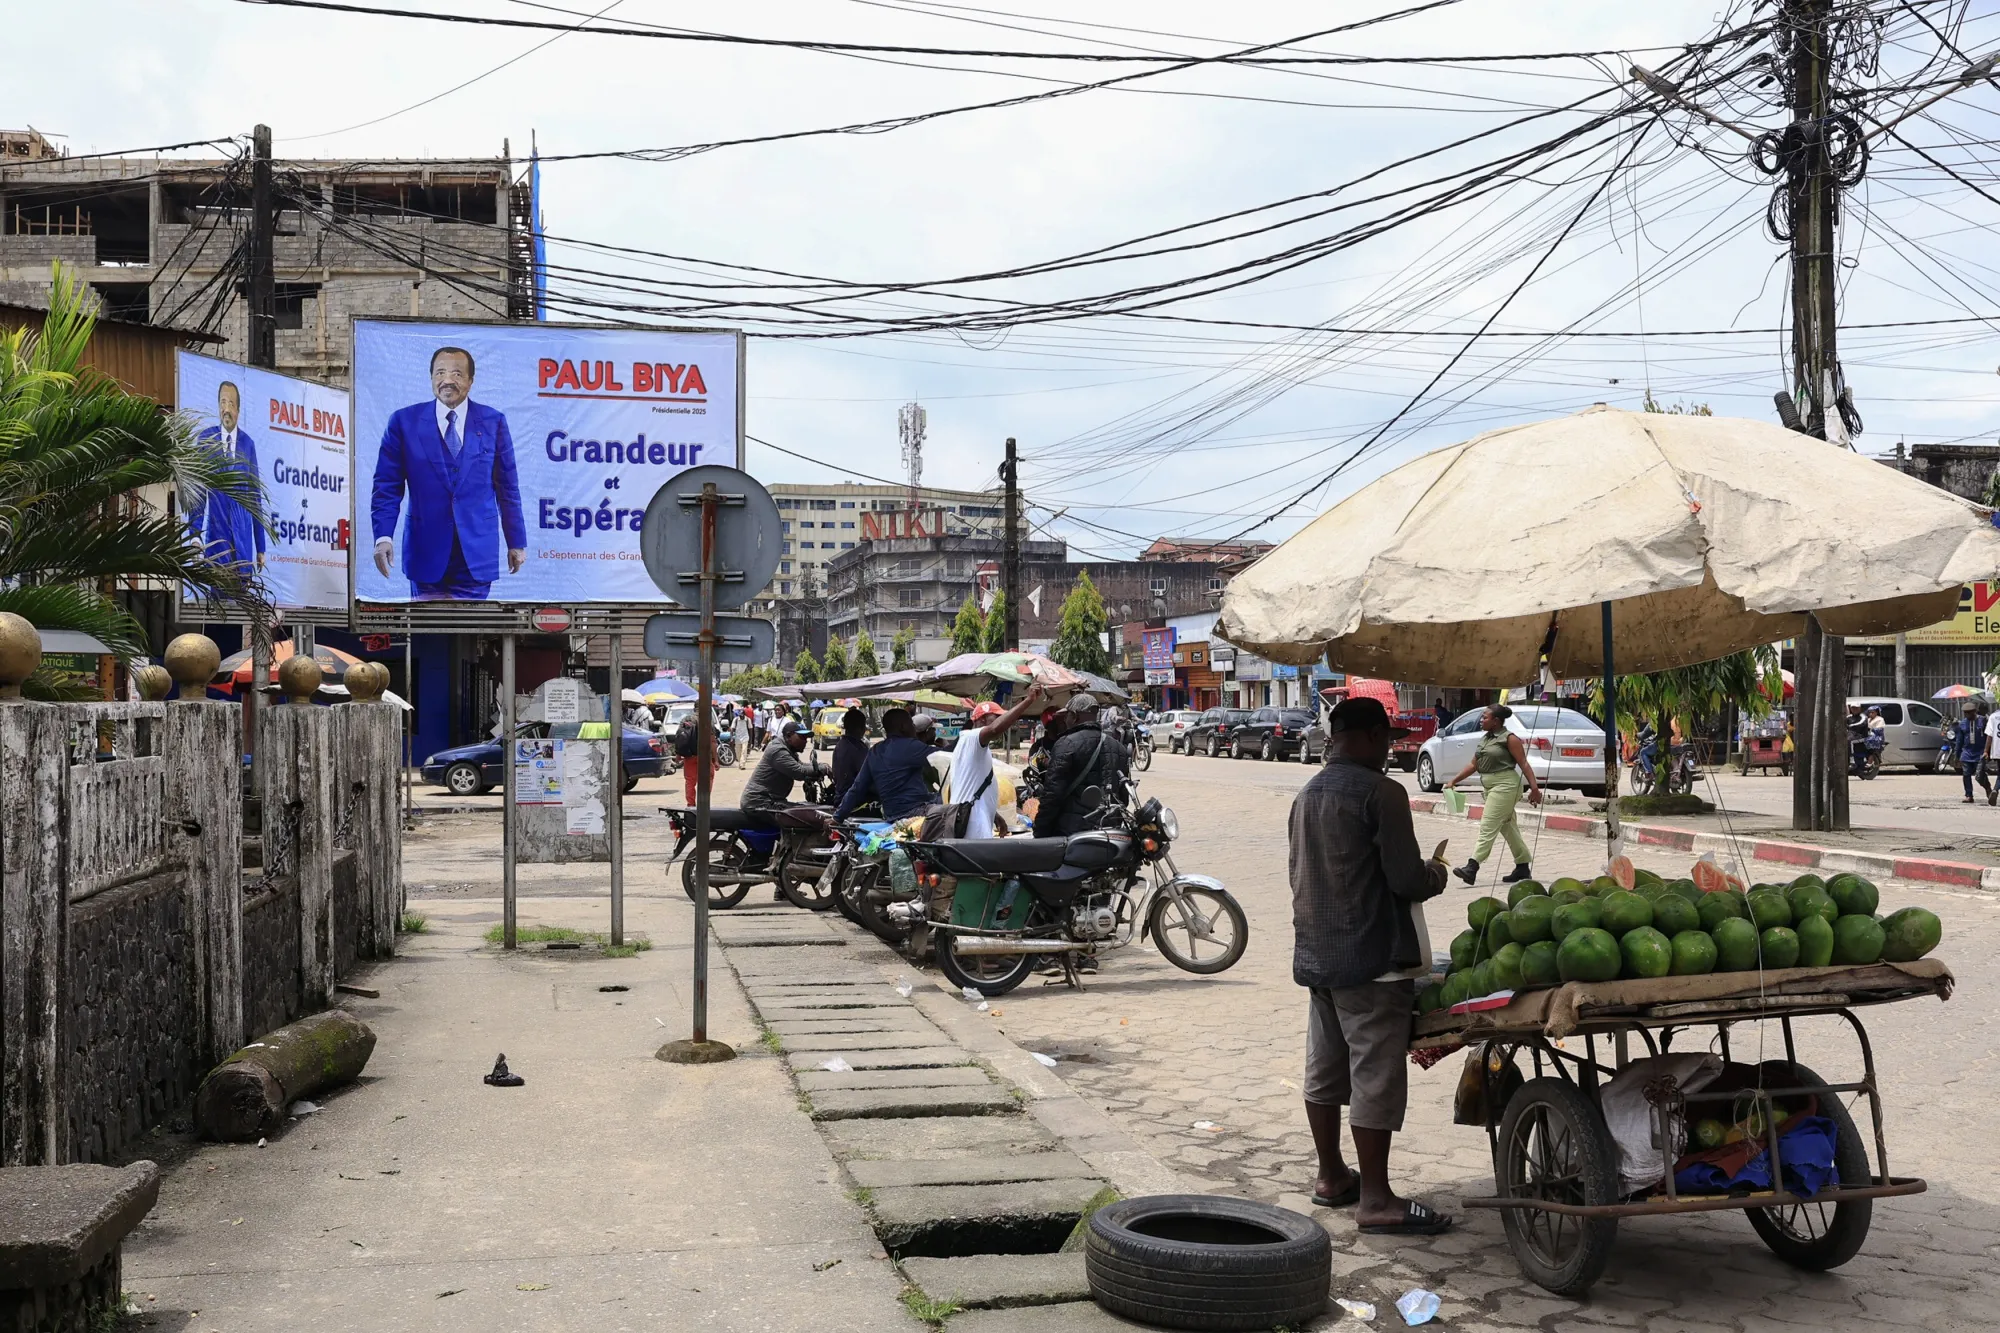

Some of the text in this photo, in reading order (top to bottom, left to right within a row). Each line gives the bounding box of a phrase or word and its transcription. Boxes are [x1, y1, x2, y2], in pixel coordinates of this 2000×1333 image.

[538, 358, 708, 395] PAUL BIYA
[270, 398, 345, 438] PAUL BIYA
[652, 406, 707, 415] Présidentielle 2025
[545, 431, 704, 465] Grandeur
[273, 456, 345, 494] Grandeur
[604, 476, 620, 489] et
[301, 498, 309, 509] et
[538, 496, 645, 538] Espéra
[271, 512, 339, 545] Espéranc
[859, 508, 948, 541] NIKI
[538, 549, 548, 559] Le
[549, 549, 597, 562] Septennat
[599, 550, 616, 560] des
[40, 657, 75, 668] ATIQUE
